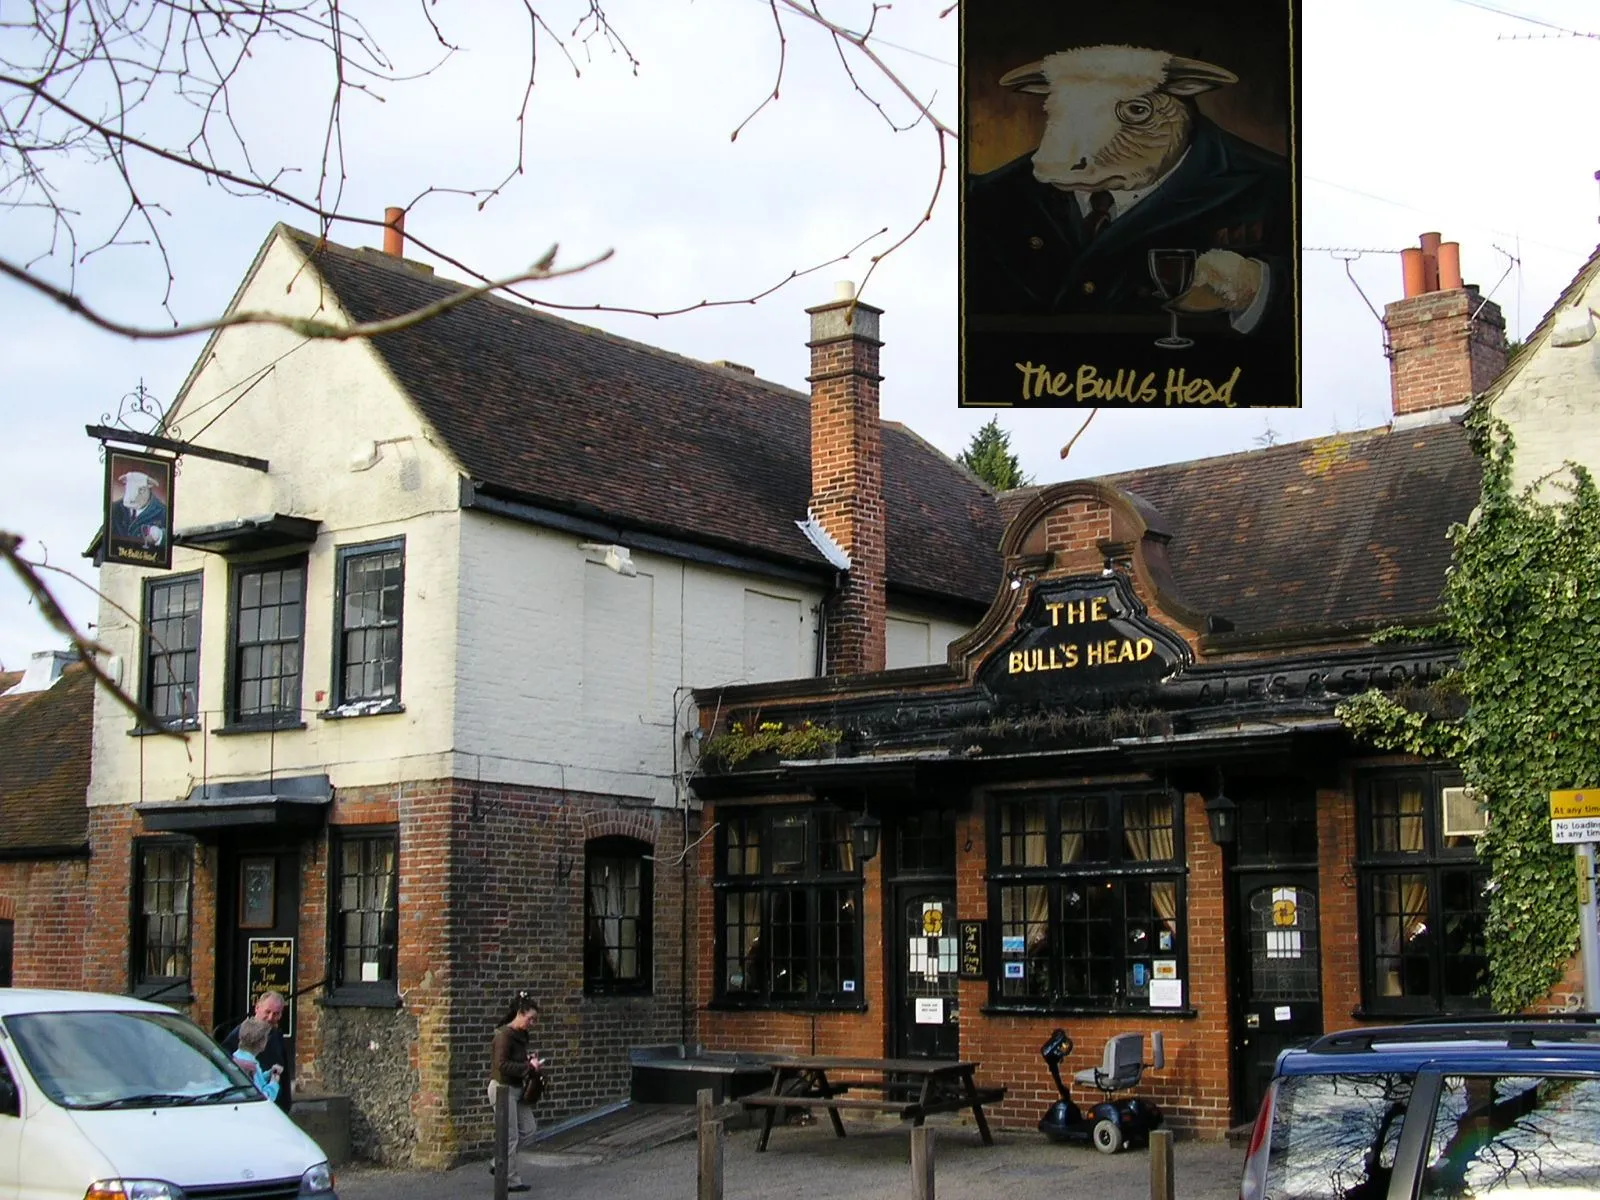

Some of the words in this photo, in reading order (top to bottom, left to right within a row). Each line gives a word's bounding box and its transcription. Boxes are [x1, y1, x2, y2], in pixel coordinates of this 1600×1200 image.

[1045, 596, 1108, 627] THE
[1008, 643, 1080, 674] BULL'S
[1087, 637, 1155, 667] HEAD
[1567, 806, 1583, 815] any
[1556, 822, 1569, 831] No
[1556, 831, 1565, 839] at
[1568, 831, 1583, 839] any
